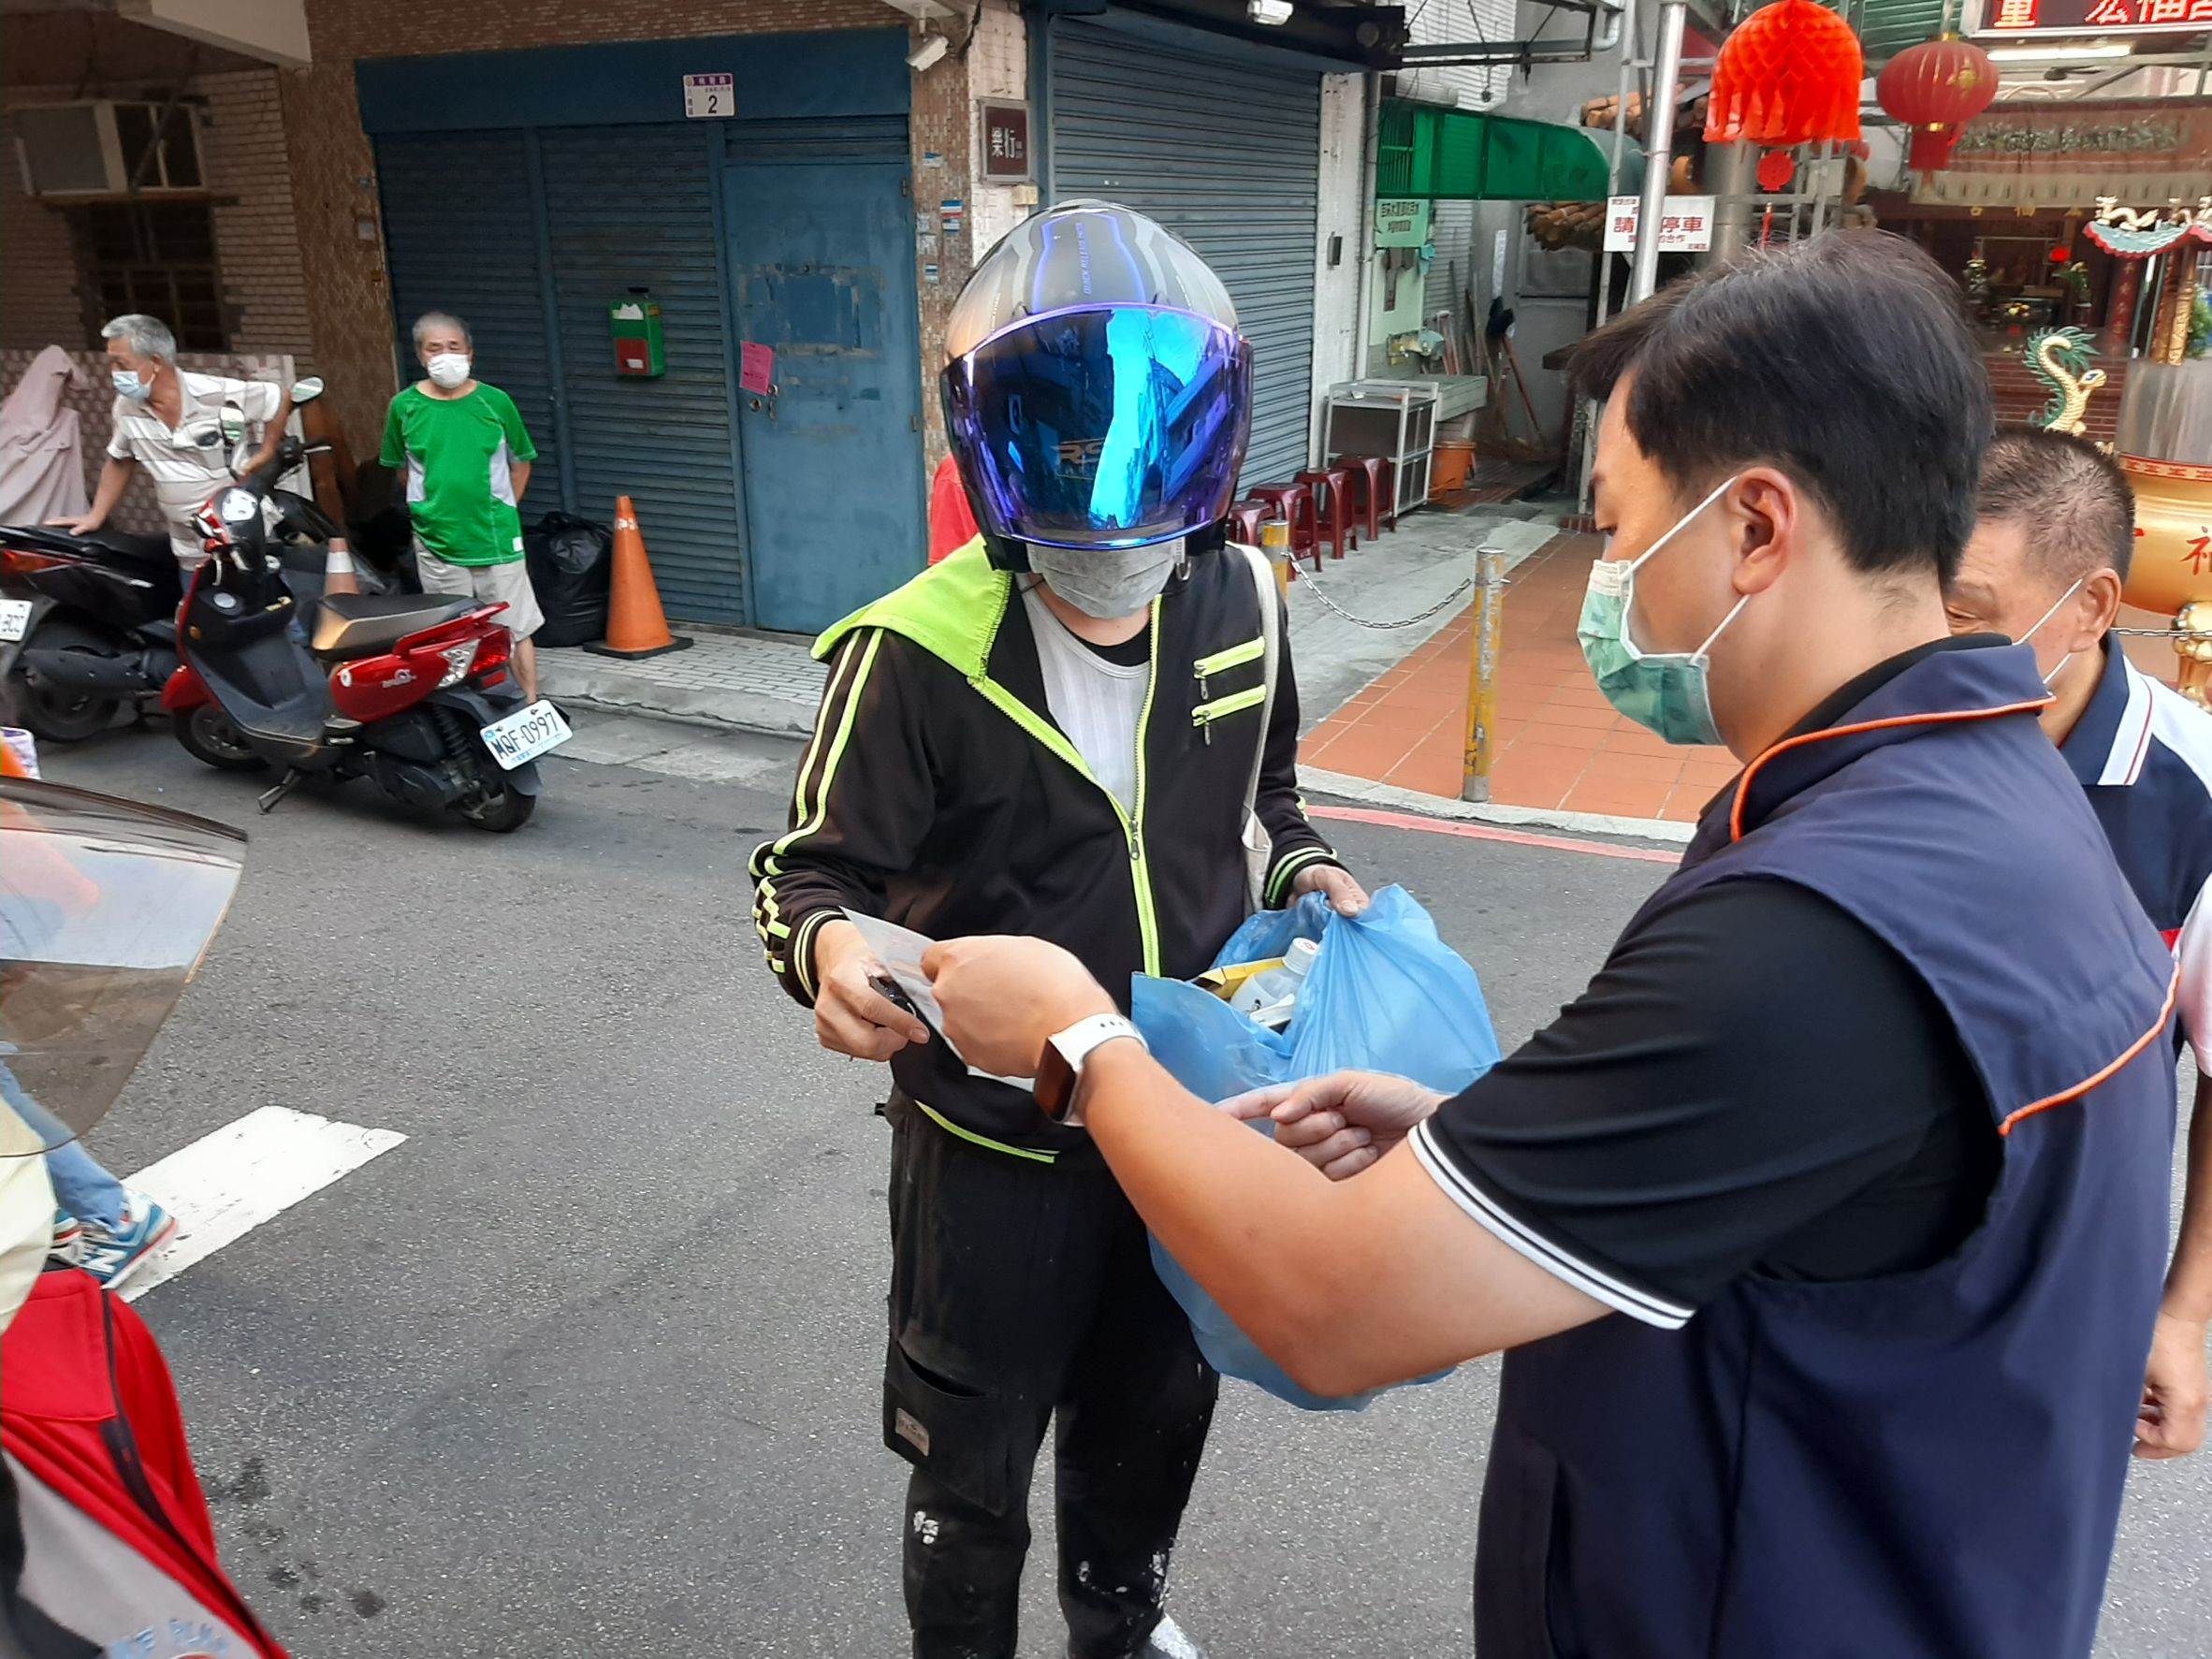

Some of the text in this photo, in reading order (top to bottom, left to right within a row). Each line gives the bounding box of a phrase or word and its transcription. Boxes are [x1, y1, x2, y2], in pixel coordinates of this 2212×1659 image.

[708, 95, 718, 113] 2
[1614, 216, 1704, 233] 請停車
